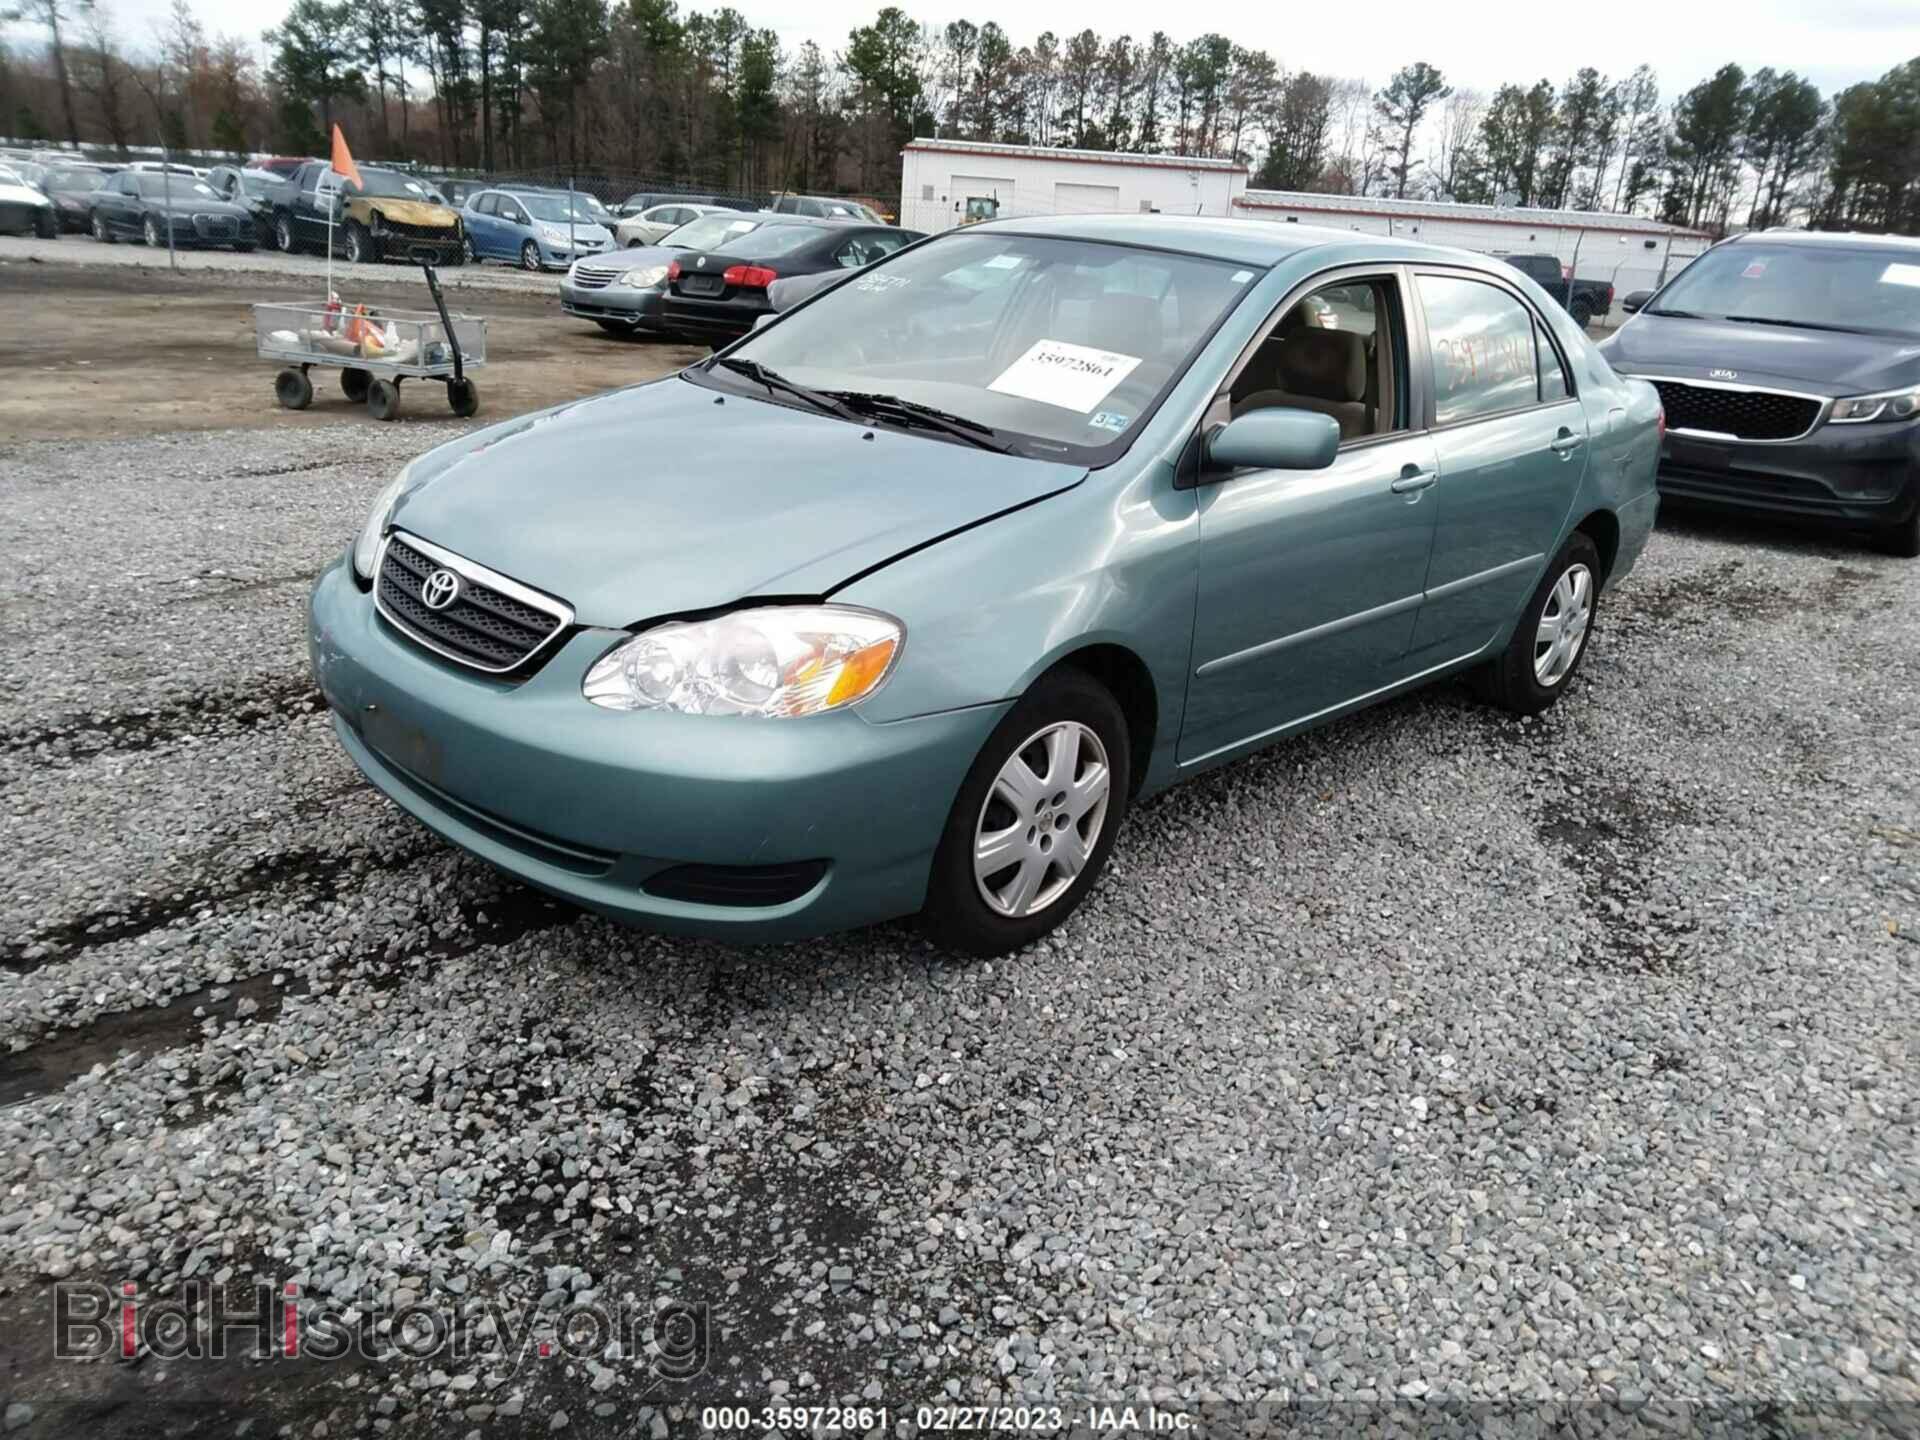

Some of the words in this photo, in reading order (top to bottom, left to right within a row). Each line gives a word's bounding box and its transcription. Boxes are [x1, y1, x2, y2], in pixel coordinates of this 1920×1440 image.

[1031, 351, 1114, 377] 35972861
[1711, 368, 1736, 379] KIA
[1095, 414, 1107, 424] 3
